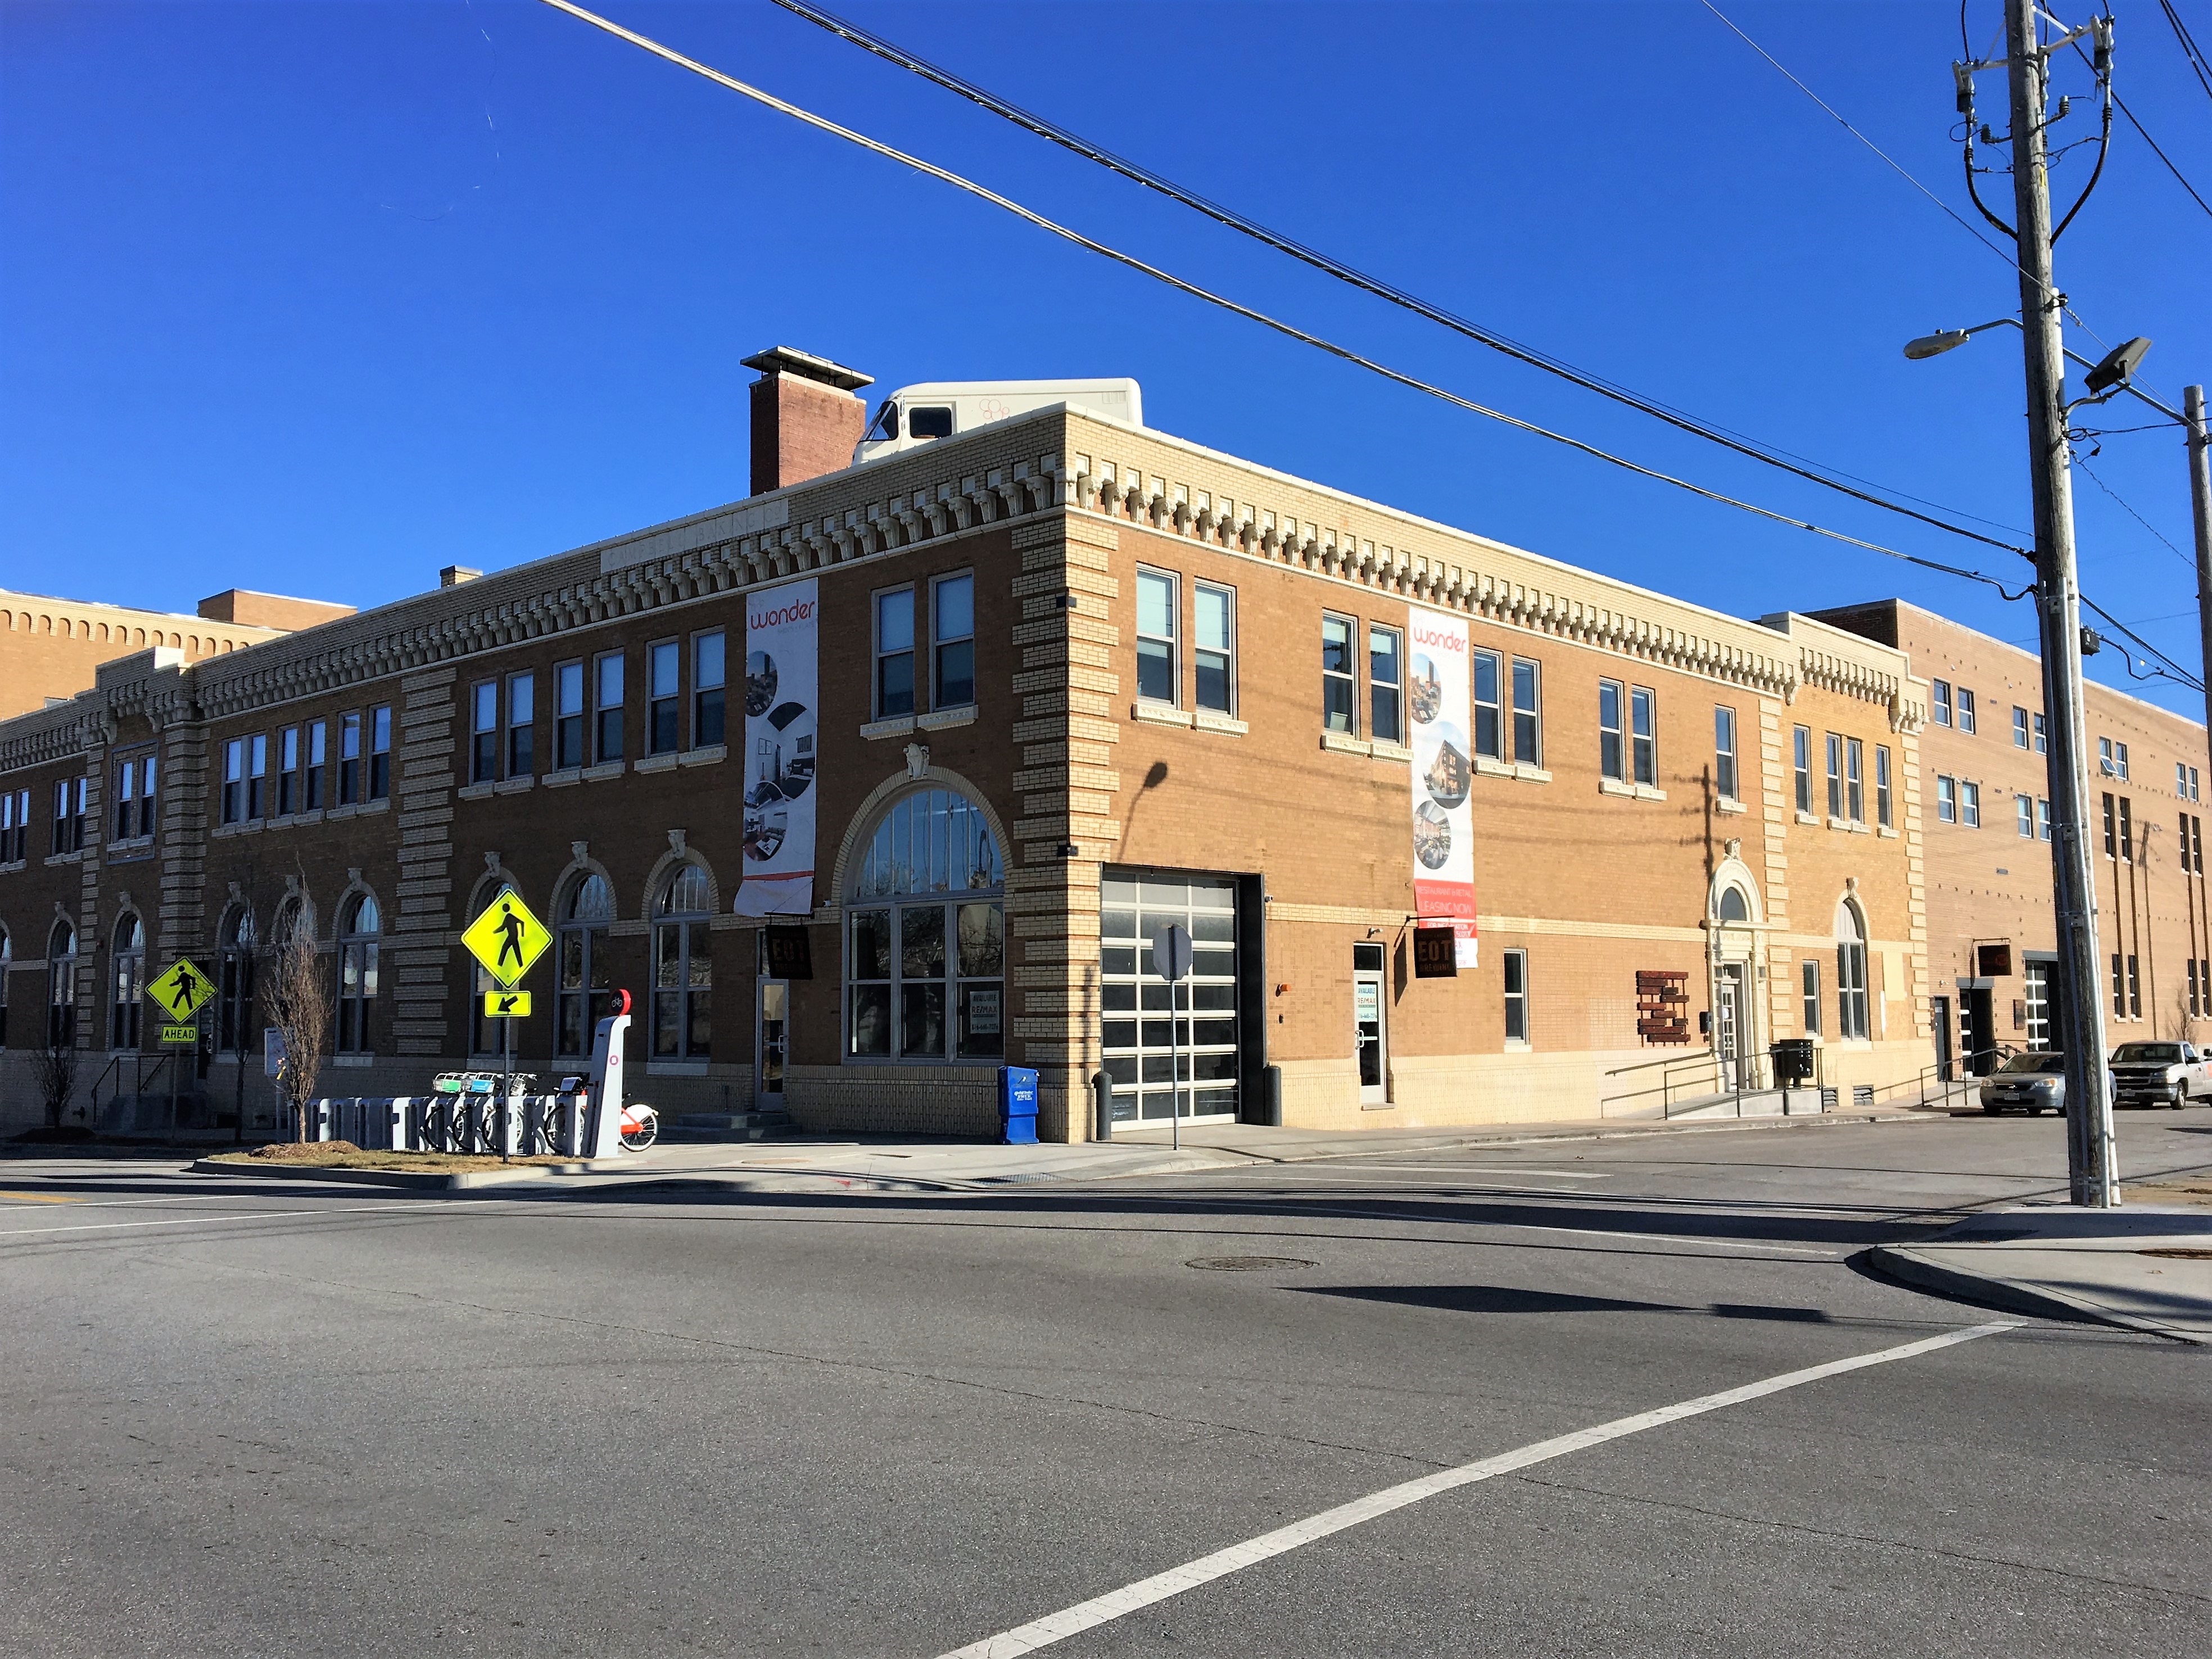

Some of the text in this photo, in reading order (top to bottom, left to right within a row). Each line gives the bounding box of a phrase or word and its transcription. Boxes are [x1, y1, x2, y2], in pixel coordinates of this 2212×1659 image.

[699, 513, 755, 541] BAKING
[750, 599, 815, 630] wonder
[1414, 627, 1466, 653] wonder
[1417, 885, 1451, 896] RESTAURANT
[1456, 889, 1472, 898] RETAIL
[1421, 901, 1472, 915] LEASING NOW
[1438, 922, 1468, 930] INFOATION
[1418, 939, 1453, 962] EOT
[164, 1029, 194, 1039] AHEAD
